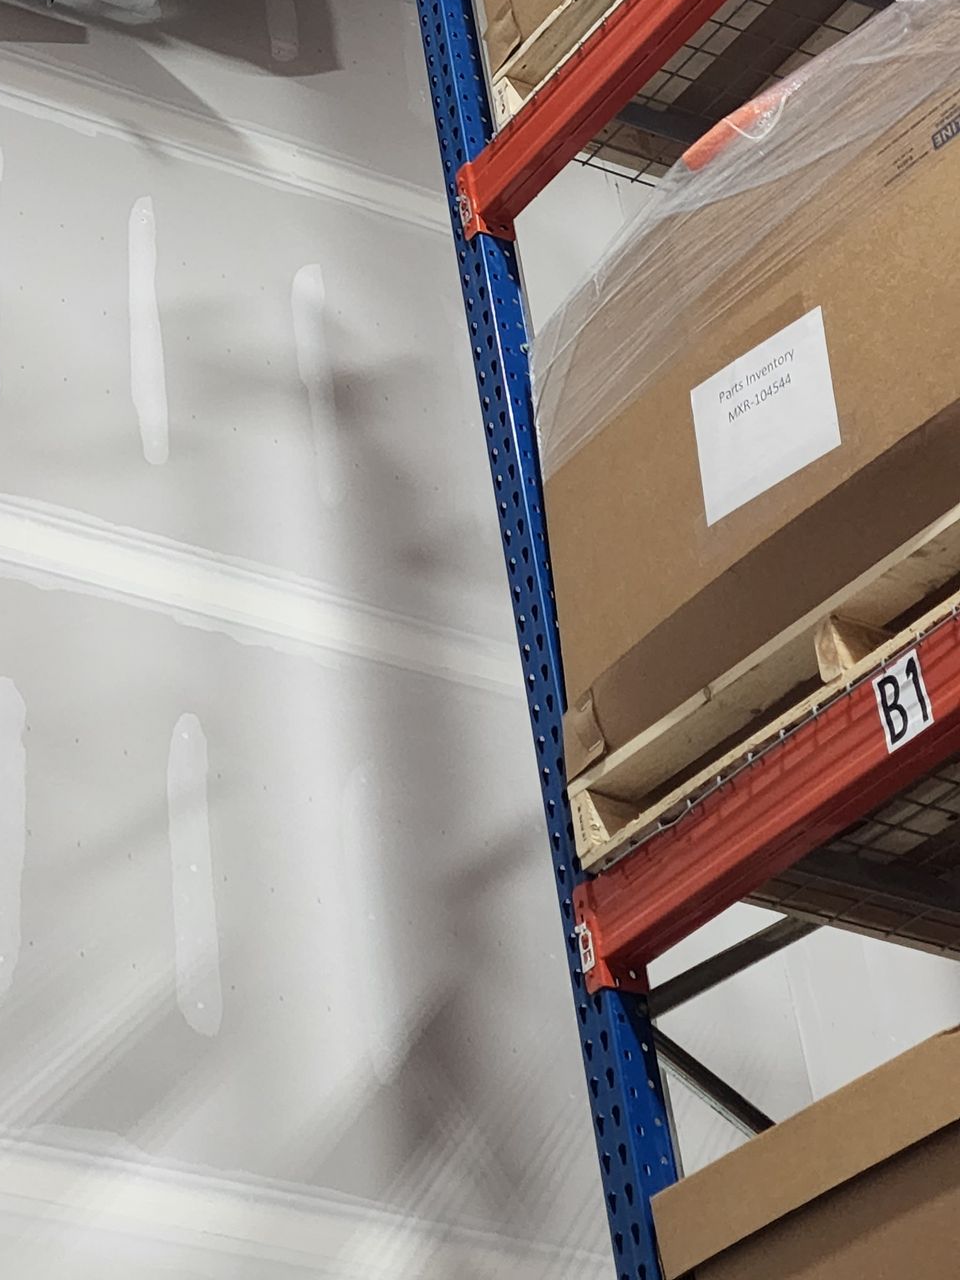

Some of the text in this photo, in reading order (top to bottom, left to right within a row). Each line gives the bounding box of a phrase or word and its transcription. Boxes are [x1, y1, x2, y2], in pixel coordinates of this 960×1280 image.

[718, 348, 794, 404] Parts Inventory
[728, 373, 791, 424] MXR-104544
[877, 656, 929, 746] B1
